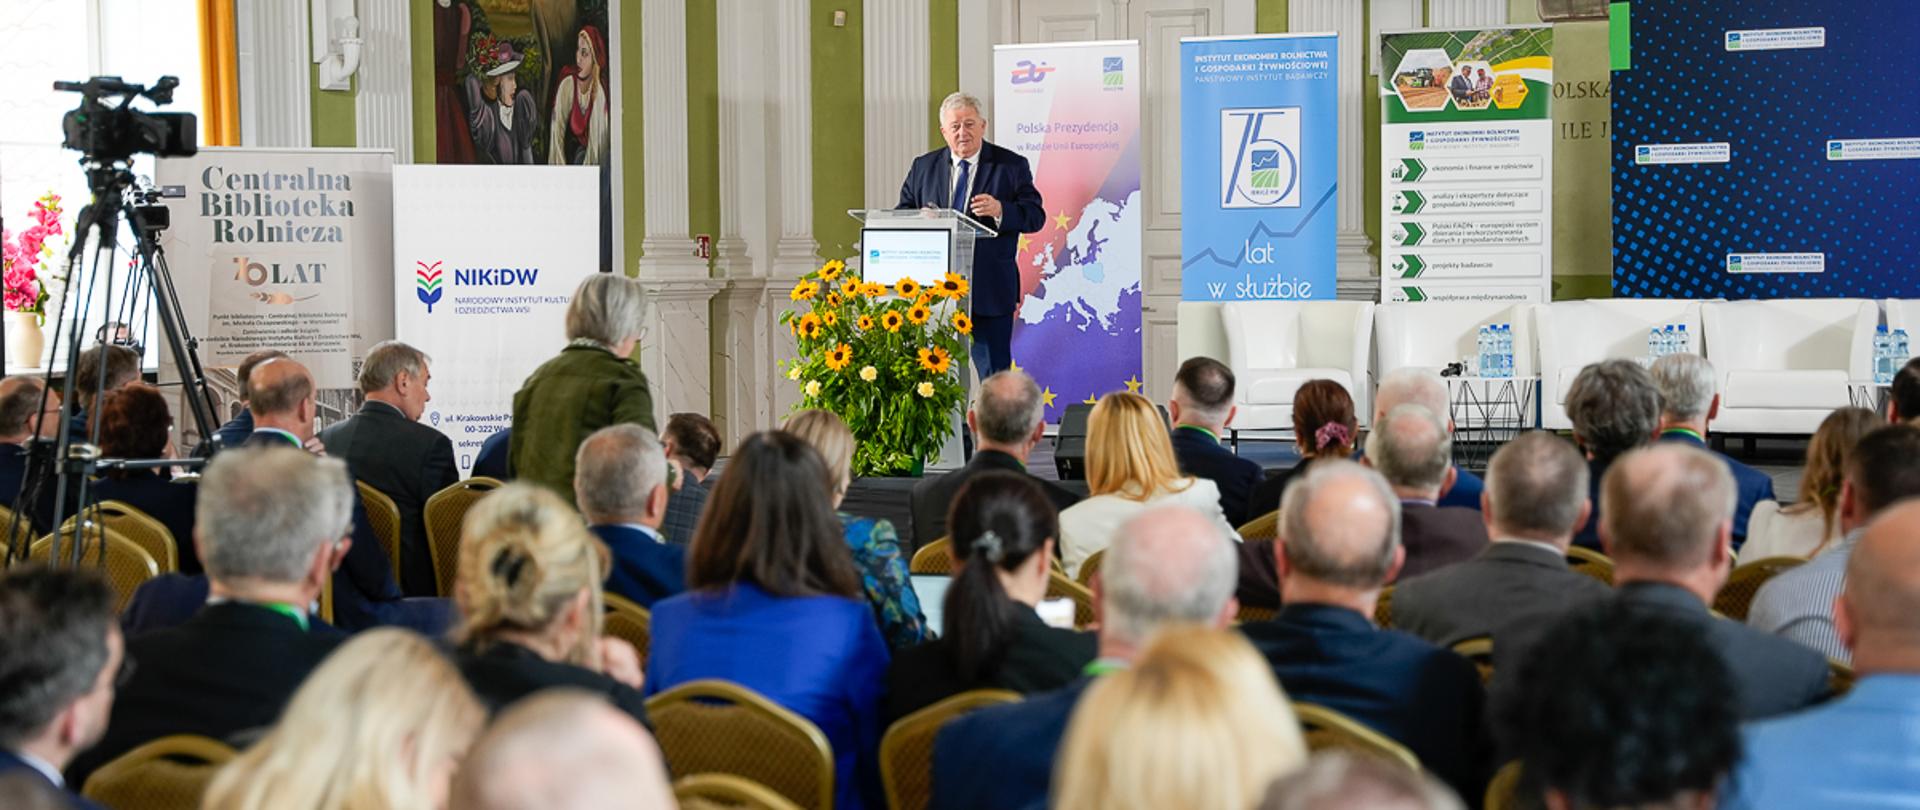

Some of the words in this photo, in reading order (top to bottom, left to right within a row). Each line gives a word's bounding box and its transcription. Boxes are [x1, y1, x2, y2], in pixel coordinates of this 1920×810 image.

[1234, 53, 1278, 61] EKONOMIKI
[1280, 51, 1328, 59] ROLNICTWA
[1201, 64, 1256, 72] GOSPODARKI
[1259, 60, 1328, 71] ŻYWNOŚCIOWEJ
[1017, 123, 1051, 134] Polska
[1055, 122, 1119, 135] Prezydencja
[1561, 121, 1592, 140] ILE
[1026, 143, 1052, 151] Radzie
[1070, 142, 1120, 151] Europejskiej
[202, 166, 352, 191] Centralna
[200, 193, 354, 217] Biblioteka
[213, 219, 344, 244] Rolnicza
[1245, 238, 1274, 265] lat
[233, 257, 268, 286] 70
[272, 264, 327, 284] LAT
[455, 268, 538, 286] NIKiDW
[1207, 281, 1227, 299] w
[1235, 273, 1312, 299] służbie
[505, 296, 543, 304] INSTYTUT
[515, 306, 530, 314] WSI
[457, 414, 502, 422] Krakowskie
[465, 425, 493, 433] 00-322
